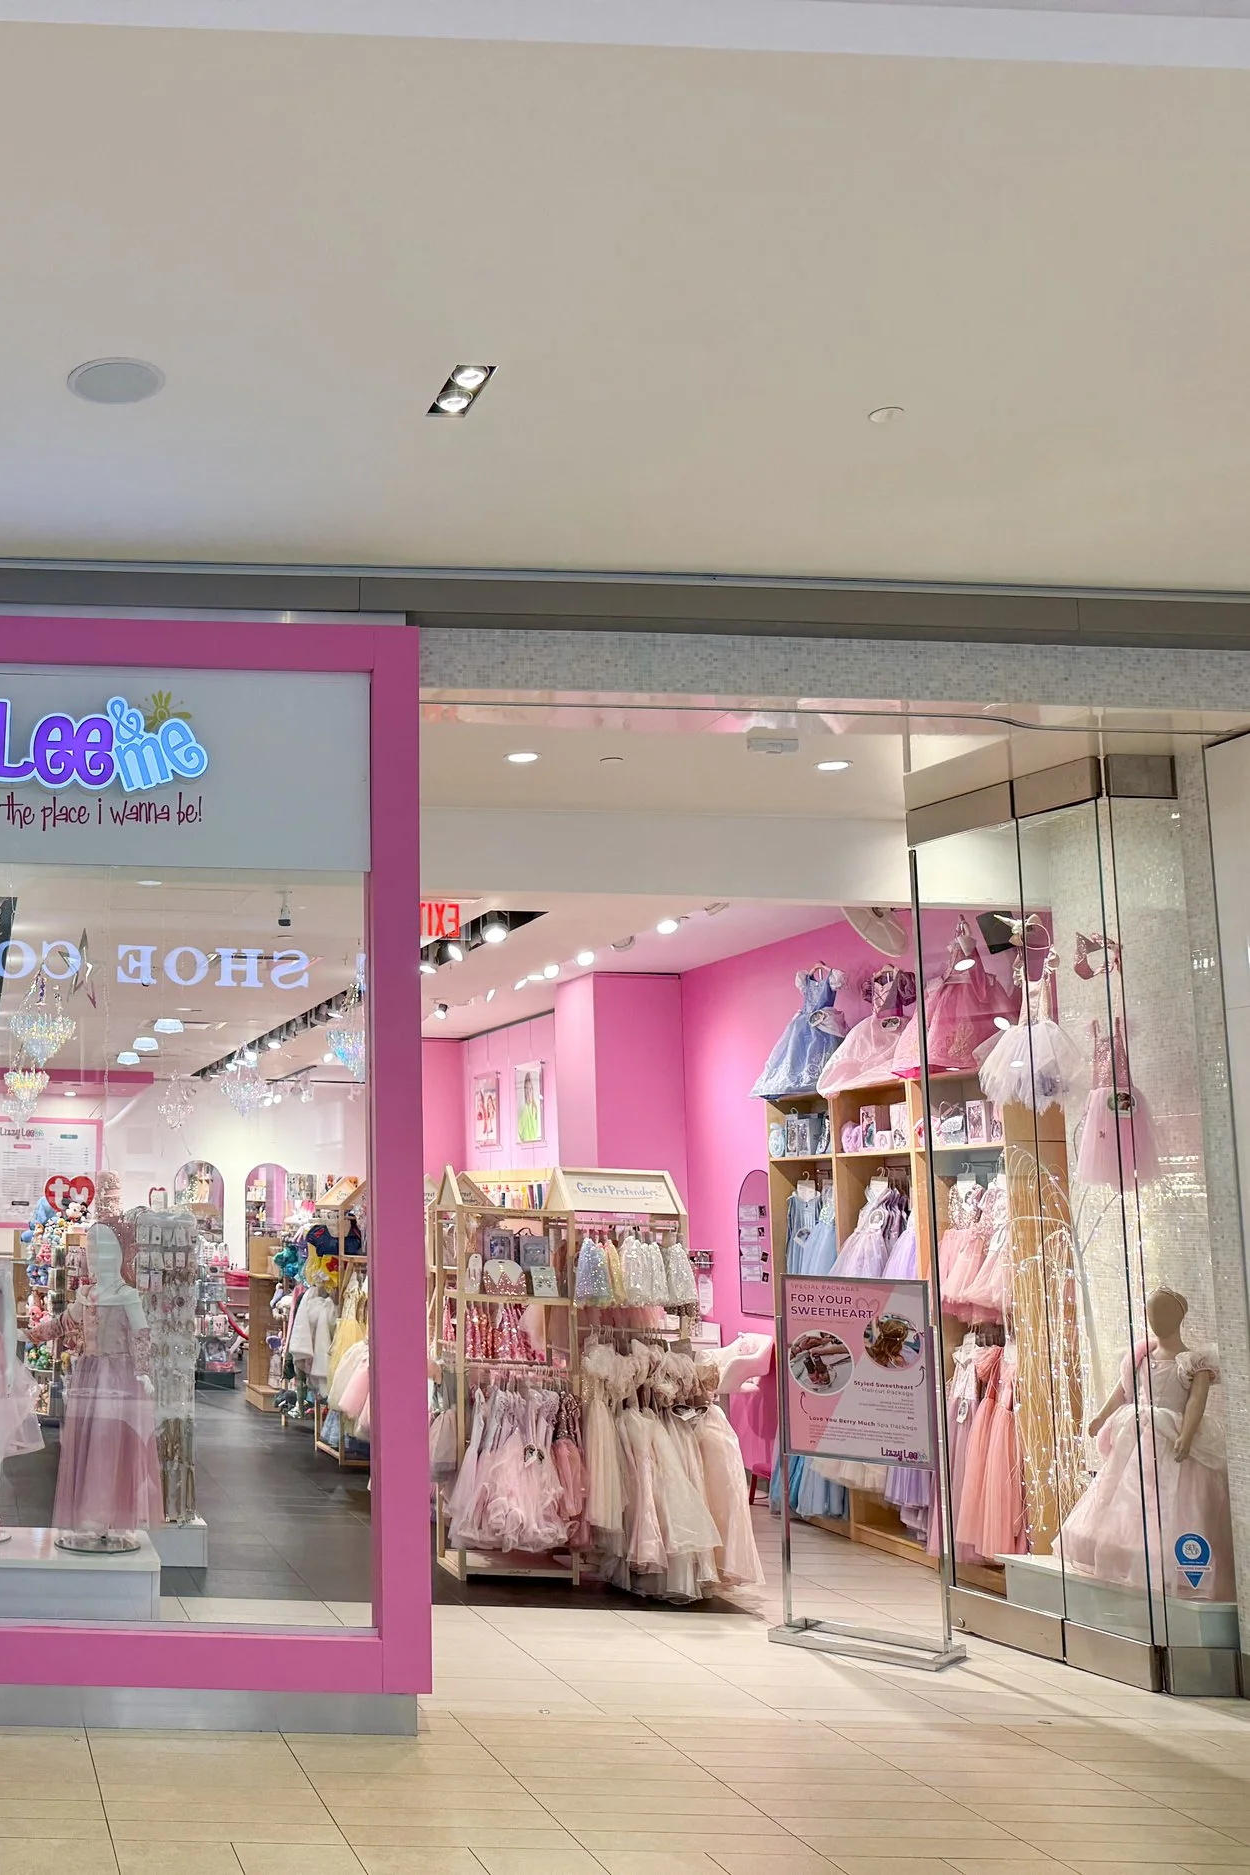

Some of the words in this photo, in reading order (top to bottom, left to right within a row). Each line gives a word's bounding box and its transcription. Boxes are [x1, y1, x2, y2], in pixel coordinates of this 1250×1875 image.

[117, 718, 206, 792] me
[0, 792, 35, 828] the
[40, 796, 90, 831] place
[97, 797, 103, 825] i
[110, 802, 170, 825] wanna
[177, 794, 203, 824] be!
[576, 1182, 607, 1194] Great
[791, 1293, 814, 1303] FOR
[818, 1295, 852, 1305] YOUR
[791, 1306, 873, 1319] SWEETHEART
[854, 1380, 874, 1388] Styled
[875, 1382, 914, 1391] Sweetheart
[886, 1389, 914, 1398] Package
[839, 1418, 856, 1426] Berry
[881, 1447, 903, 1462] Lizzy
